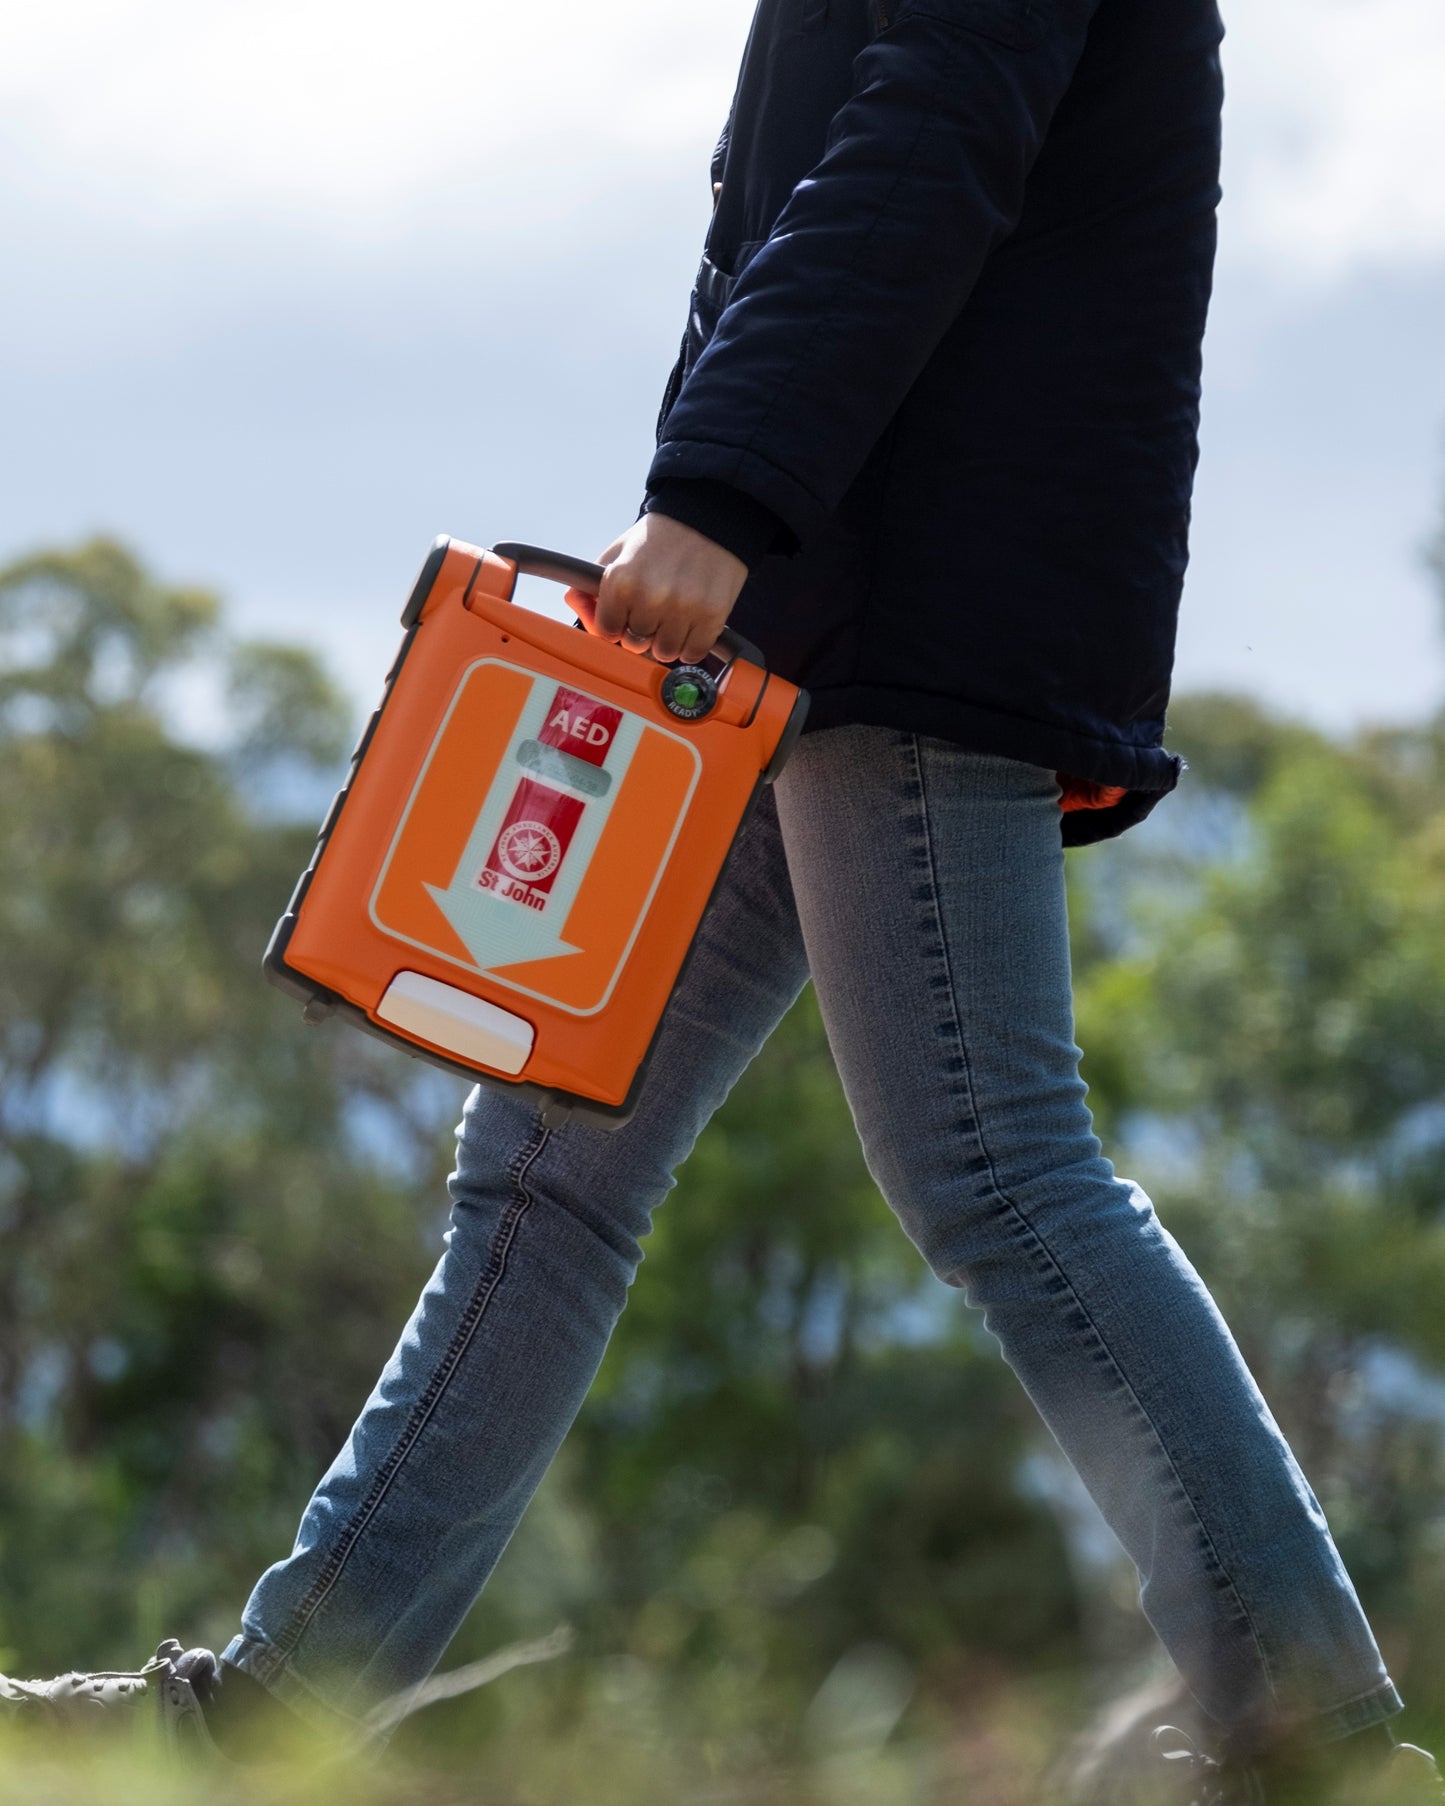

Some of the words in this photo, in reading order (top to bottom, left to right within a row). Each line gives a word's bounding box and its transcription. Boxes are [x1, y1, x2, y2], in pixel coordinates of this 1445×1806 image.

[549, 709, 610, 746] AED
[668, 701, 698, 717] READY
[478, 870, 499, 891] St
[501, 881, 546, 911] John
